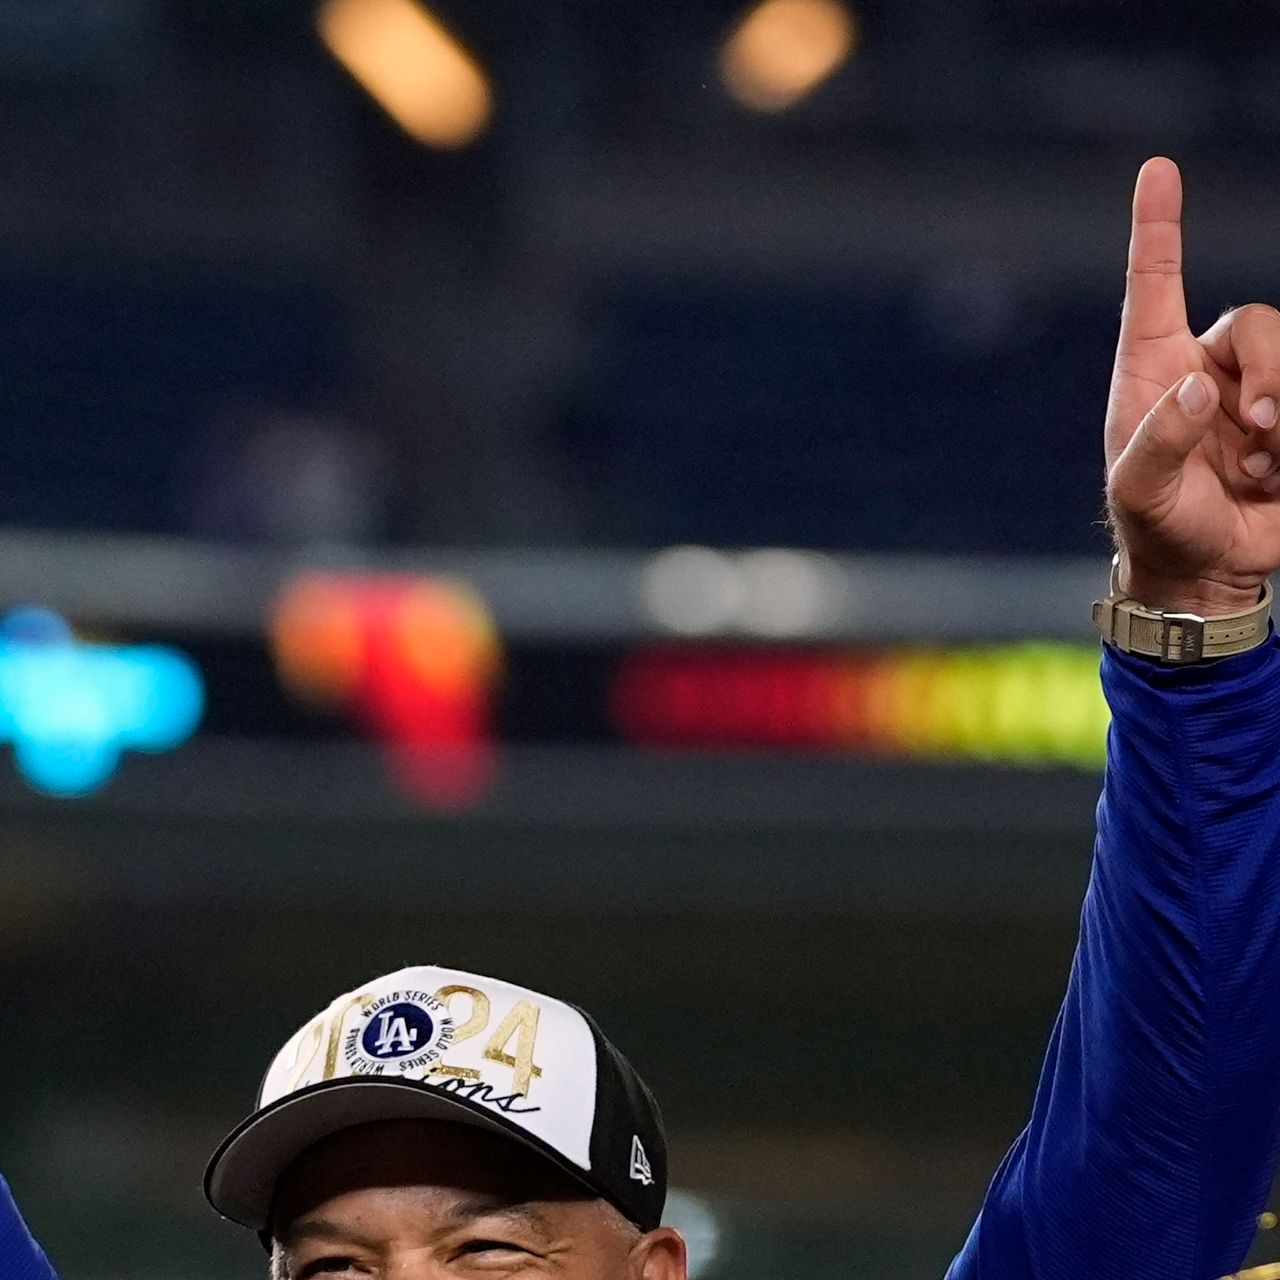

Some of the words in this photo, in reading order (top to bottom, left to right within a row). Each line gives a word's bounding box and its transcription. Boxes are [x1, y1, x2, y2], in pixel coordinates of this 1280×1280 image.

[361, 991, 401, 1018] WORLD
[403, 989, 444, 1012] SERIES
[375, 1010, 418, 1056] LA
[439, 1016, 456, 1051] WORLD
[399, 1048, 440, 1072] SERIES
